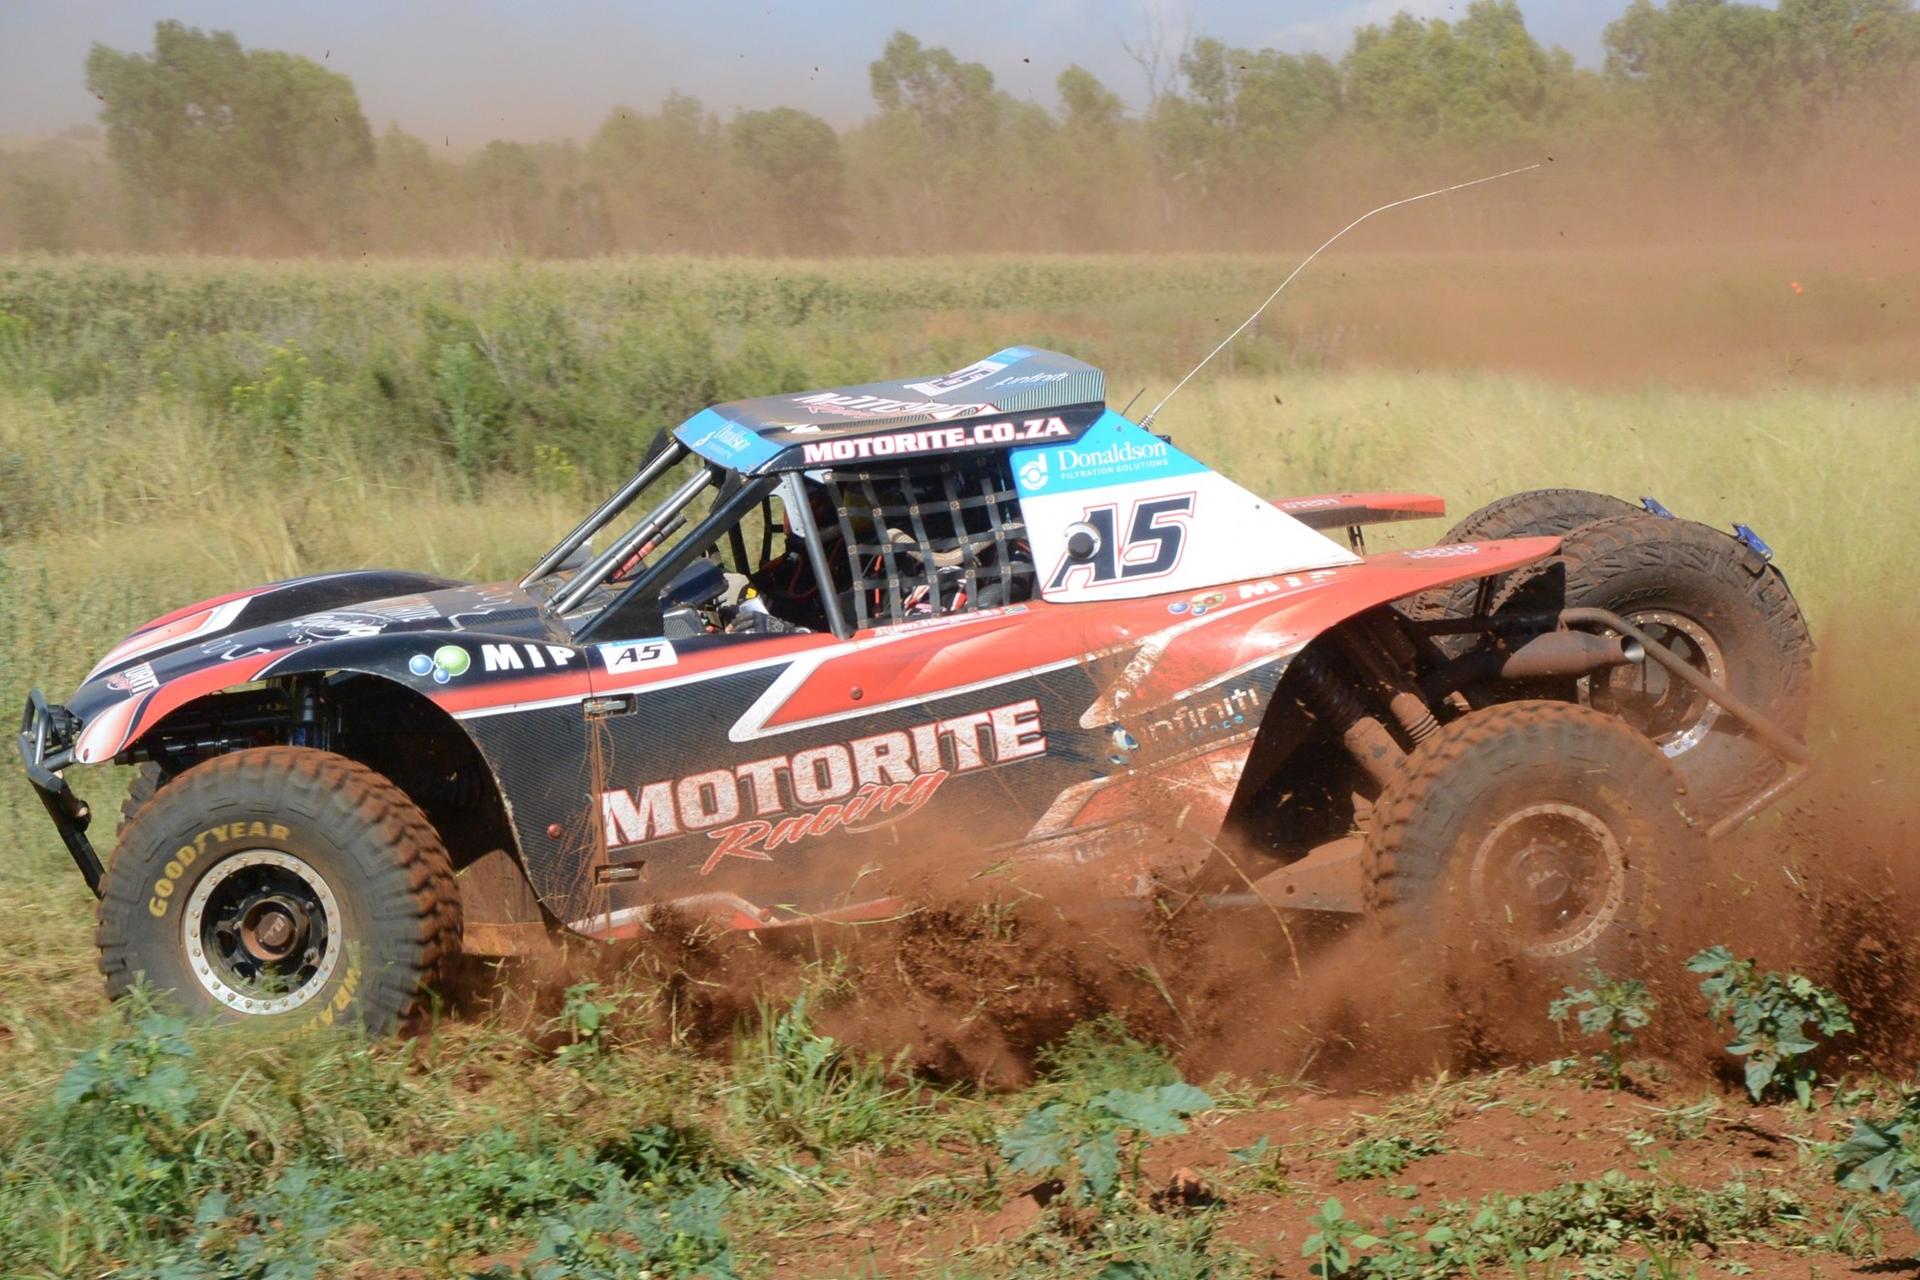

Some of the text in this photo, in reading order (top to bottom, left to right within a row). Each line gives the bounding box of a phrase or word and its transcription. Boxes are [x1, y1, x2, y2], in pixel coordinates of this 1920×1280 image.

[802, 417, 1071, 464] MOTORITE.CO.ZA
[1057, 440, 1168, 471] Donaldson
[1060, 458, 1169, 480] FILTRATION SOLUTIONS
[1042, 491, 1197, 594] A5
[481, 643, 576, 672] MIP
[615, 644, 665, 666] A5
[601, 699, 1048, 848] MOTORITE
[700, 769, 950, 876] Racing
[149, 821, 291, 918] GOODYEAR
